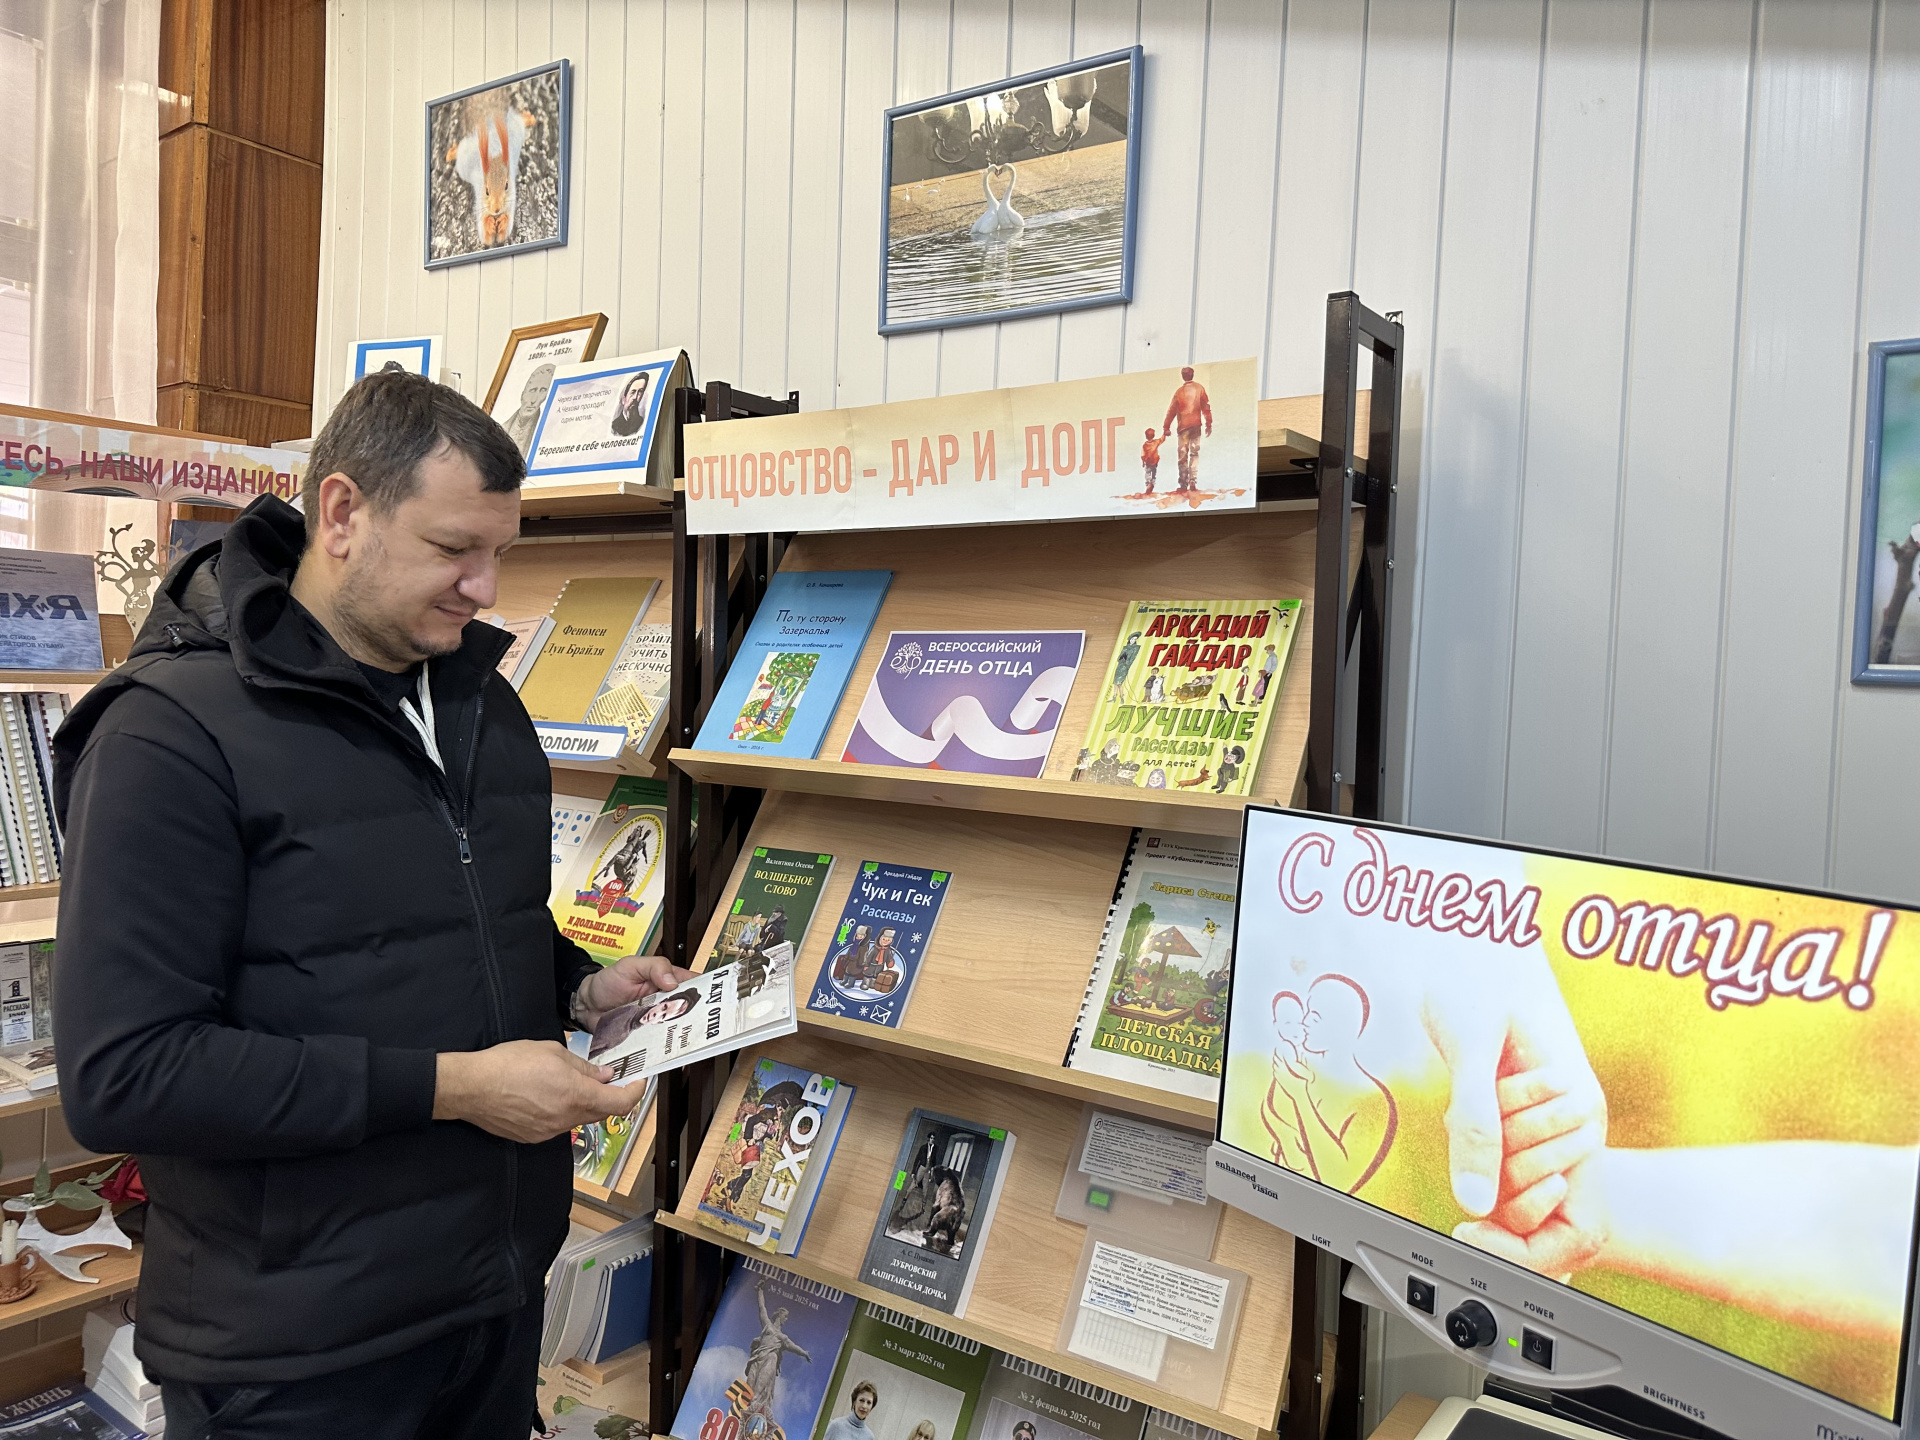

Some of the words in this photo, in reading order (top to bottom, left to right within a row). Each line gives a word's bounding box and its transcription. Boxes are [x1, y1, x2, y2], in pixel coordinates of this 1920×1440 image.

[536, 341, 548, 349] Луи
[550, 338, 572, 347] Брайль
[554, 348, 572, 356] 1852г.
[583, 390, 611, 398] творчество
[581, 402, 606, 411] проходит
[582, 441, 598, 451] себе
[688, 446, 851, 506] ОТЦОВСТВО
[889, 435, 959, 497] ДАР
[974, 430, 996, 481] И
[1022, 417, 1124, 488] ДОЛГ
[80, 450, 164, 485] НАШИ
[172, 459, 298, 498] ИЗДАНИЯ!
[776, 610, 793, 623] По
[797, 615, 806, 624] ту
[809, 615, 846, 624] сторону
[563, 625, 607, 636] Феномен
[779, 626, 830, 636] Зазеркалья
[1145, 610, 1271, 641] АРКАДИЙ
[636, 635, 671, 643] БРАЙЛ
[929, 639, 1042, 653] ВСЕРОССИЙСКИЙ
[544, 643, 563, 656] Луи
[566, 644, 604, 657] Брайля
[632, 649, 668, 658] УЧИТЬ
[1148, 640, 1252, 671] ГАЙДАР
[618, 662, 671, 673] НЕСКУЧНО
[919, 660, 974, 675] ДЕНЬ
[978, 661, 1032, 677] ОТЦА
[1105, 705, 1258, 741] ЛУЧШИЕ
[1132, 737, 1214, 757] РАССКАЗЫ
[1143, 759, 1162, 767] для
[1166, 760, 1198, 768] детей
[765, 858, 794, 867] Валентина
[795, 861, 814, 869] Осеева
[1145, 852, 1166, 861] Проект
[1205, 859, 1233, 868] писатели
[754, 870, 814, 886] ВОЛШЕБНОЕ
[884, 870, 904, 878] Аркадий
[905, 873, 923, 881] Гайдар
[609, 882, 622, 891] 100
[764, 884, 797, 896] СЛОВО
[862, 882, 886, 901] Чук
[891, 891, 902, 901] и
[905, 889, 933, 907] Гек
[1151, 882, 1194, 896] Лариса
[861, 905, 916, 924] Рассказы
[1278, 832, 1335, 914] С
[1344, 827, 1542, 948] днем
[1561, 893, 1896, 1011] отца!
[567, 916, 573, 925] И
[574, 918, 606, 932] ДОЛЬШЕ
[606, 924, 625, 936] ВЕКА
[713, 969, 729, 979] Я
[3, 1003, 30, 1013] РАССКАЗЫ
[680, 1024, 692, 1049] Юрий
[1118, 1017, 1211, 1051] ДЕТСКАЯ
[1101, 1032, 1221, 1074] ПЛОЩАДКА
[746, 1073, 835, 1247] ЧЕХОВ
[1215, 1159, 1256, 1183] enhanced
[1252, 1182, 1278, 1199] vision
[1312, 1233, 1331, 1248] LIGHT
[914, 1252, 935, 1264] Пушкин
[1411, 1252, 1434, 1267] MODE
[890, 1258, 937, 1279] ДУБРОВСКИЙ
[871, 1268, 923, 1292] КАПИТАНСКАЯ
[922, 1286, 947, 1300] ДОЧКА
[1470, 1278, 1487, 1291] SIZE
[782, 1290, 794, 1299] май
[794, 1293, 809, 1306] 2025
[809, 1300, 819, 1311] год
[1524, 1301, 1554, 1320] POWER
[882, 1339, 892, 1350] №
[893, 1342, 898, 1351] 3
[898, 1345, 916, 1360] март
[916, 1349, 934, 1365] 2025
[933, 1356, 946, 1370] год
[6, 1387, 73, 1417] ЖИЗНЬ
[1018, 1390, 1028, 1400] №
[1028, 1393, 1034, 1402] 2
[1035, 1396, 1068, 1419] февраль
[1068, 1406, 1088, 1423] 2025
[1089, 1416, 1101, 1430] год
[1643, 1385, 1706, 1420] BRIGHTNESS
[700, 1408, 740, 1440] 80
